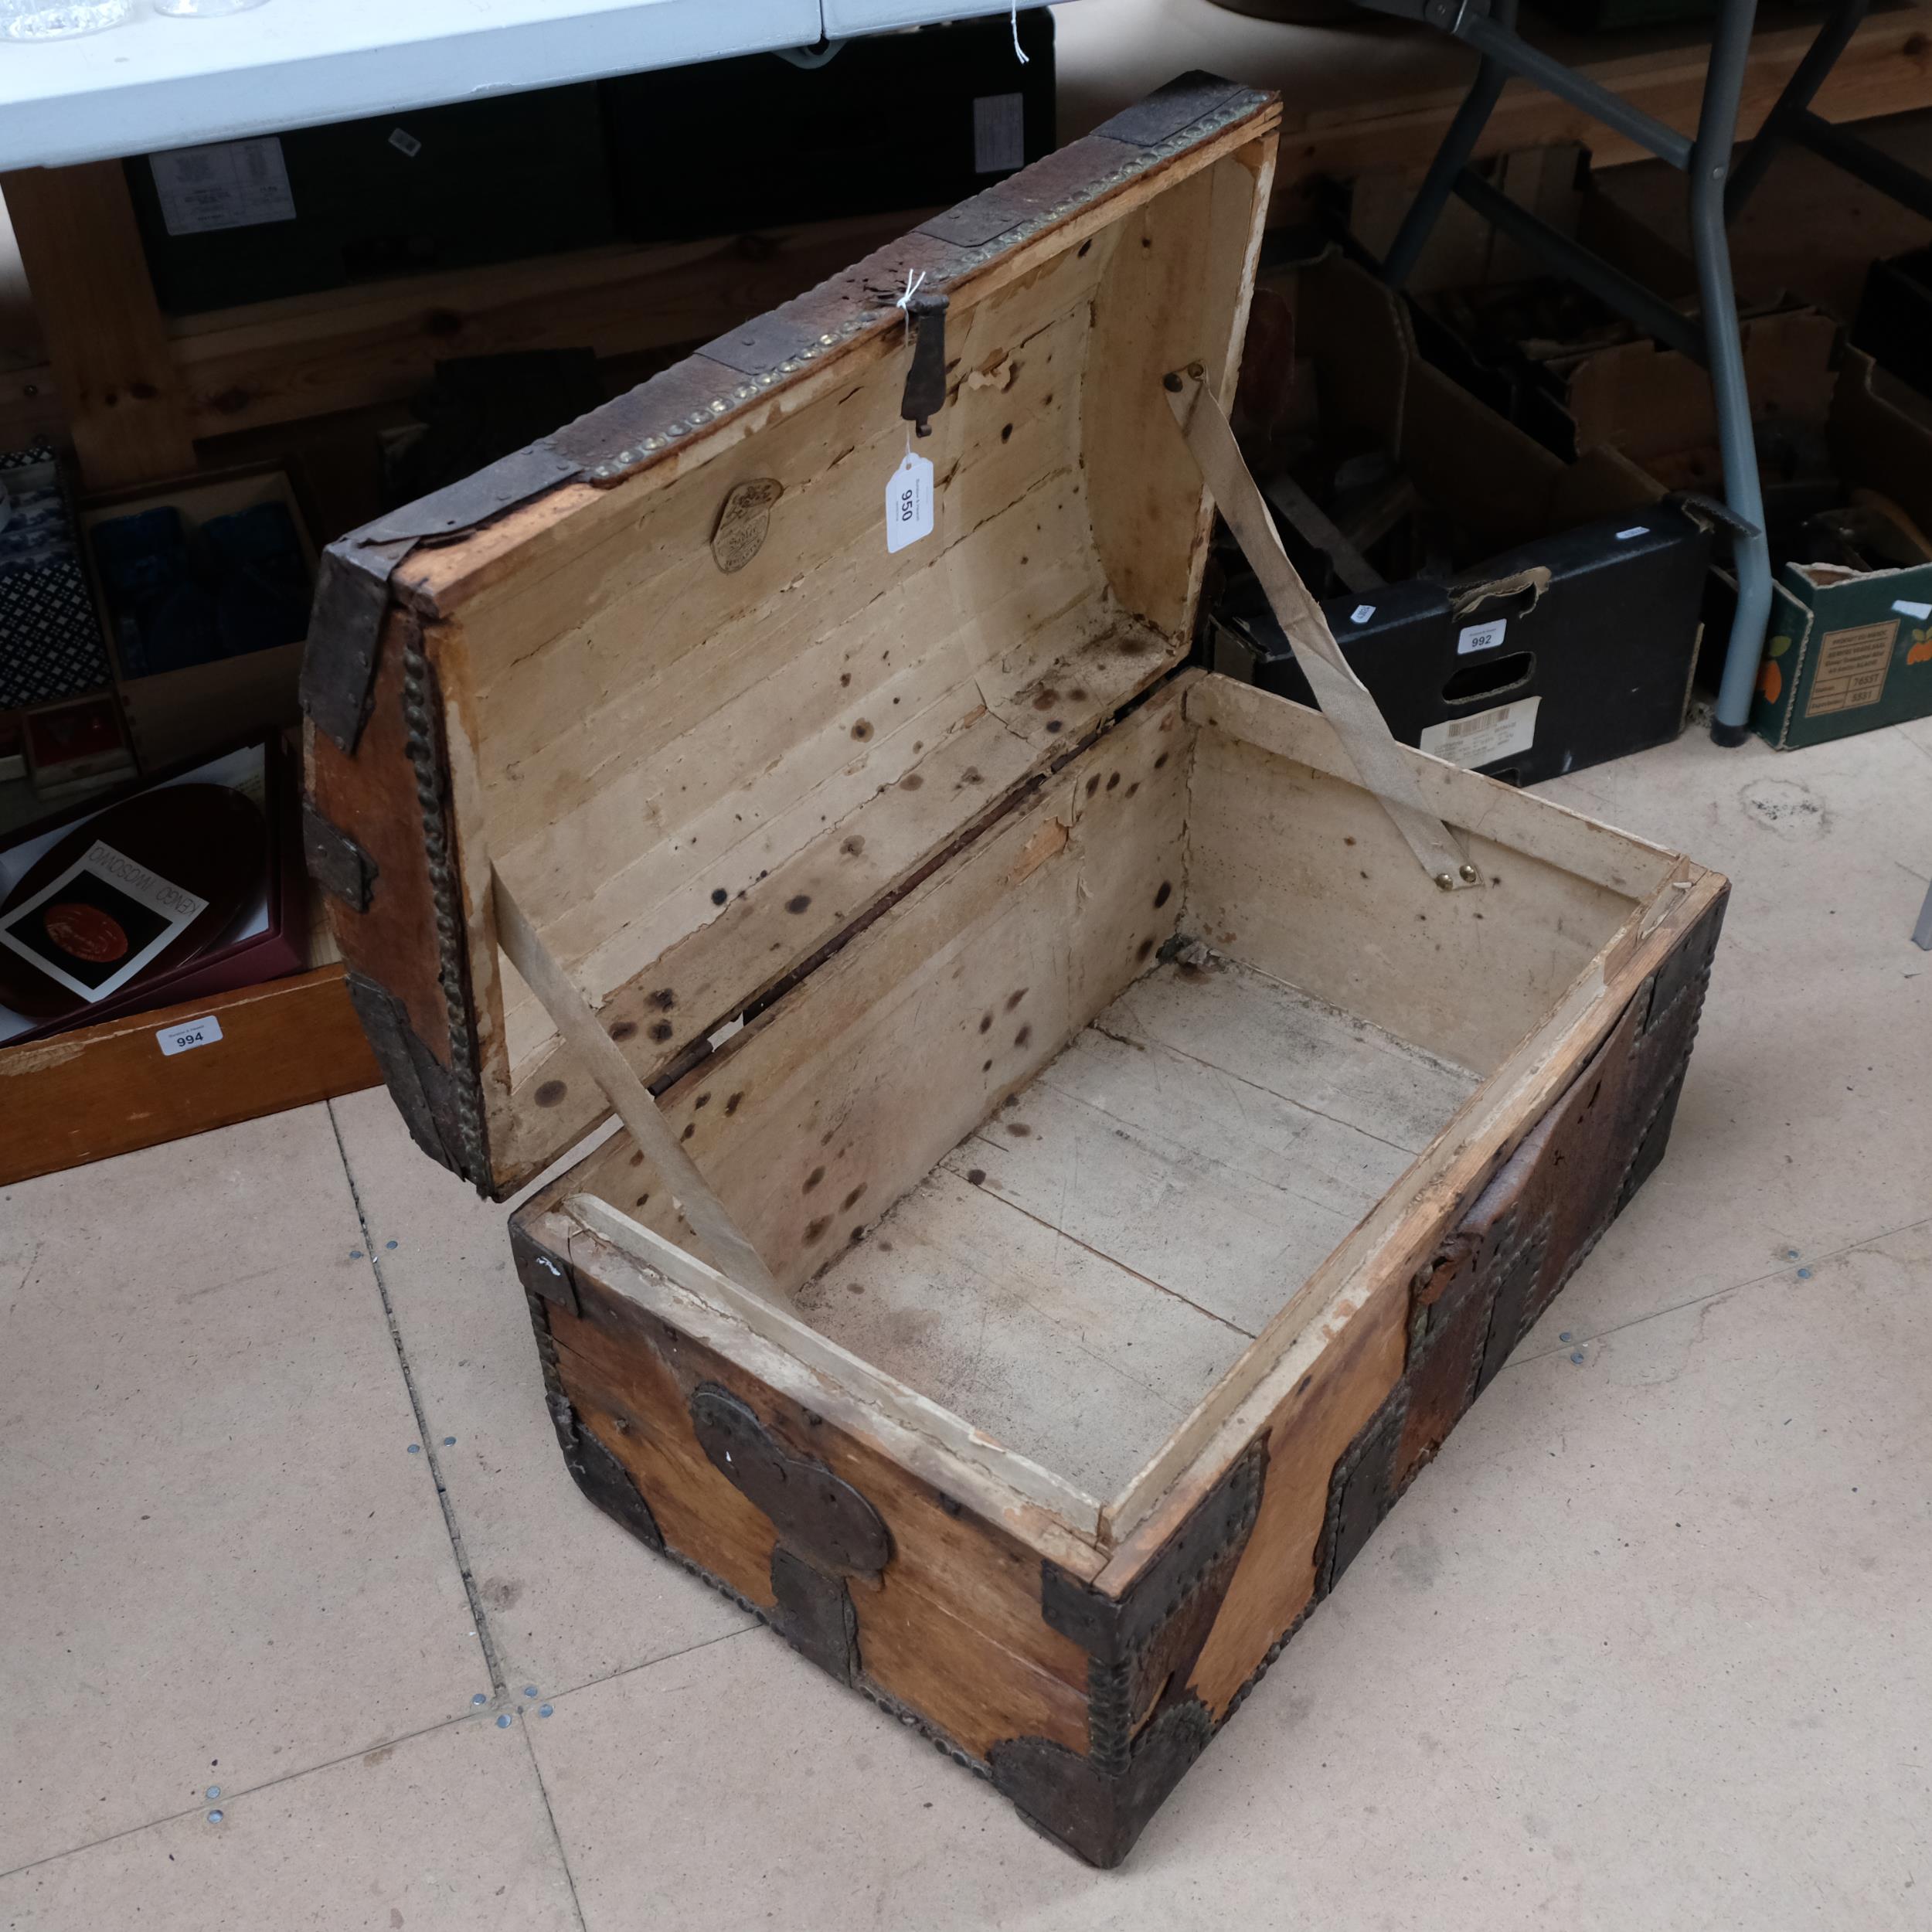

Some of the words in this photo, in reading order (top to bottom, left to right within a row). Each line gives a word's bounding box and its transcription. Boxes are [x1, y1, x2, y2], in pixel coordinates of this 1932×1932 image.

[901, 489, 913, 522] 950
[1471, 634, 1492, 648] 992
[156, 886, 200, 917] KENGO
[177, 1032, 204, 1047] 994
